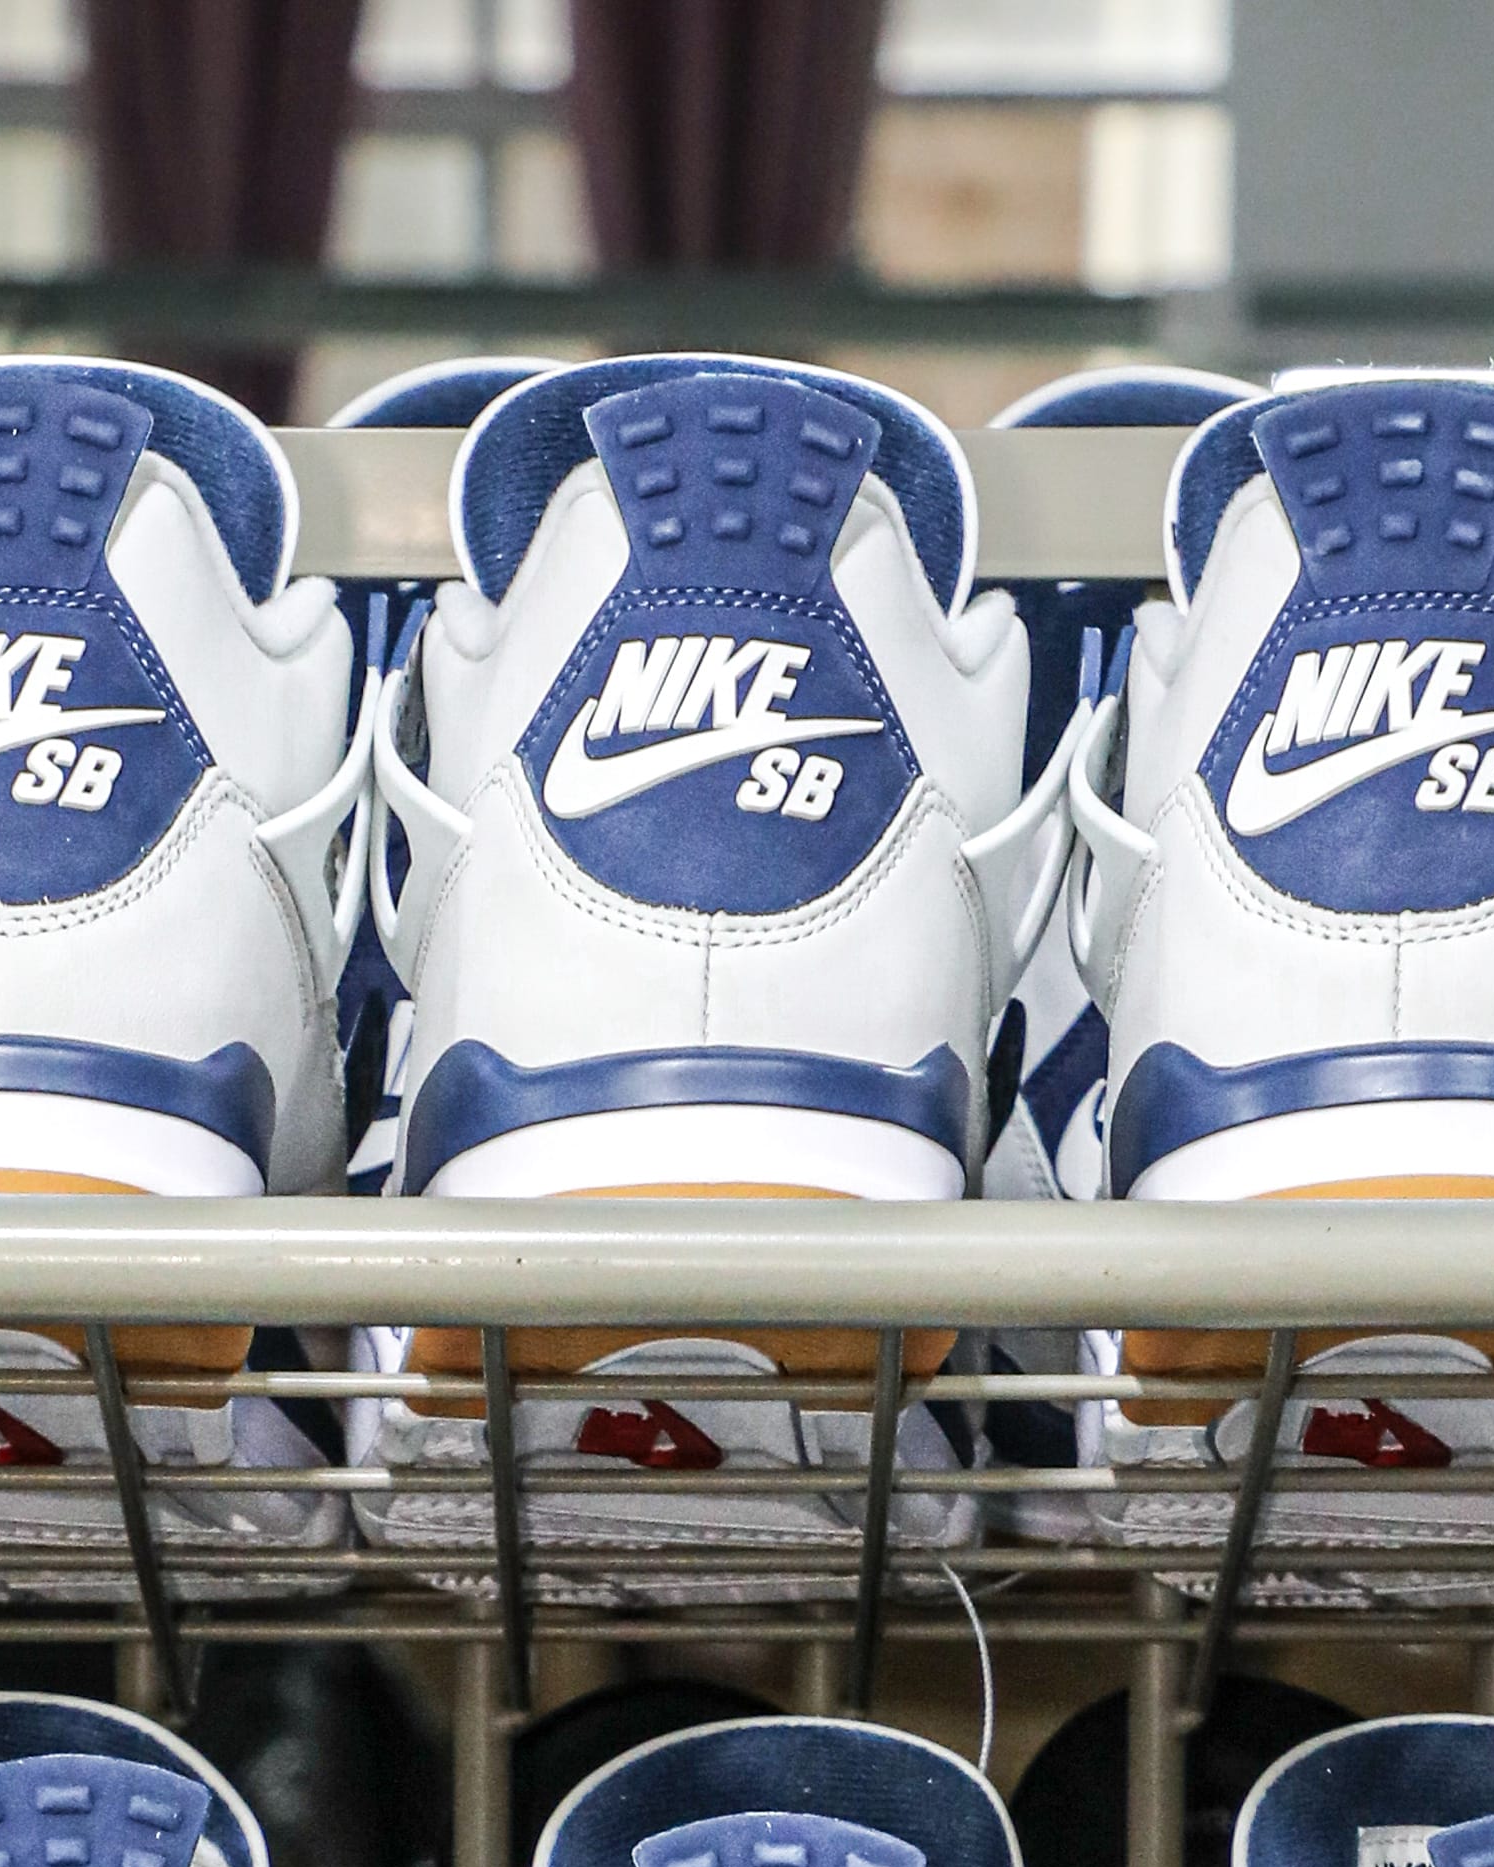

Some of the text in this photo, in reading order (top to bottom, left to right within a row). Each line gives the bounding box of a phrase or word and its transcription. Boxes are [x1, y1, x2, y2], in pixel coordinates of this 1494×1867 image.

[586, 635, 809, 739] NIKE
[1264, 639, 1486, 751] NIKE
[9, 736, 125, 814] SB
[733, 745, 846, 823] SB
